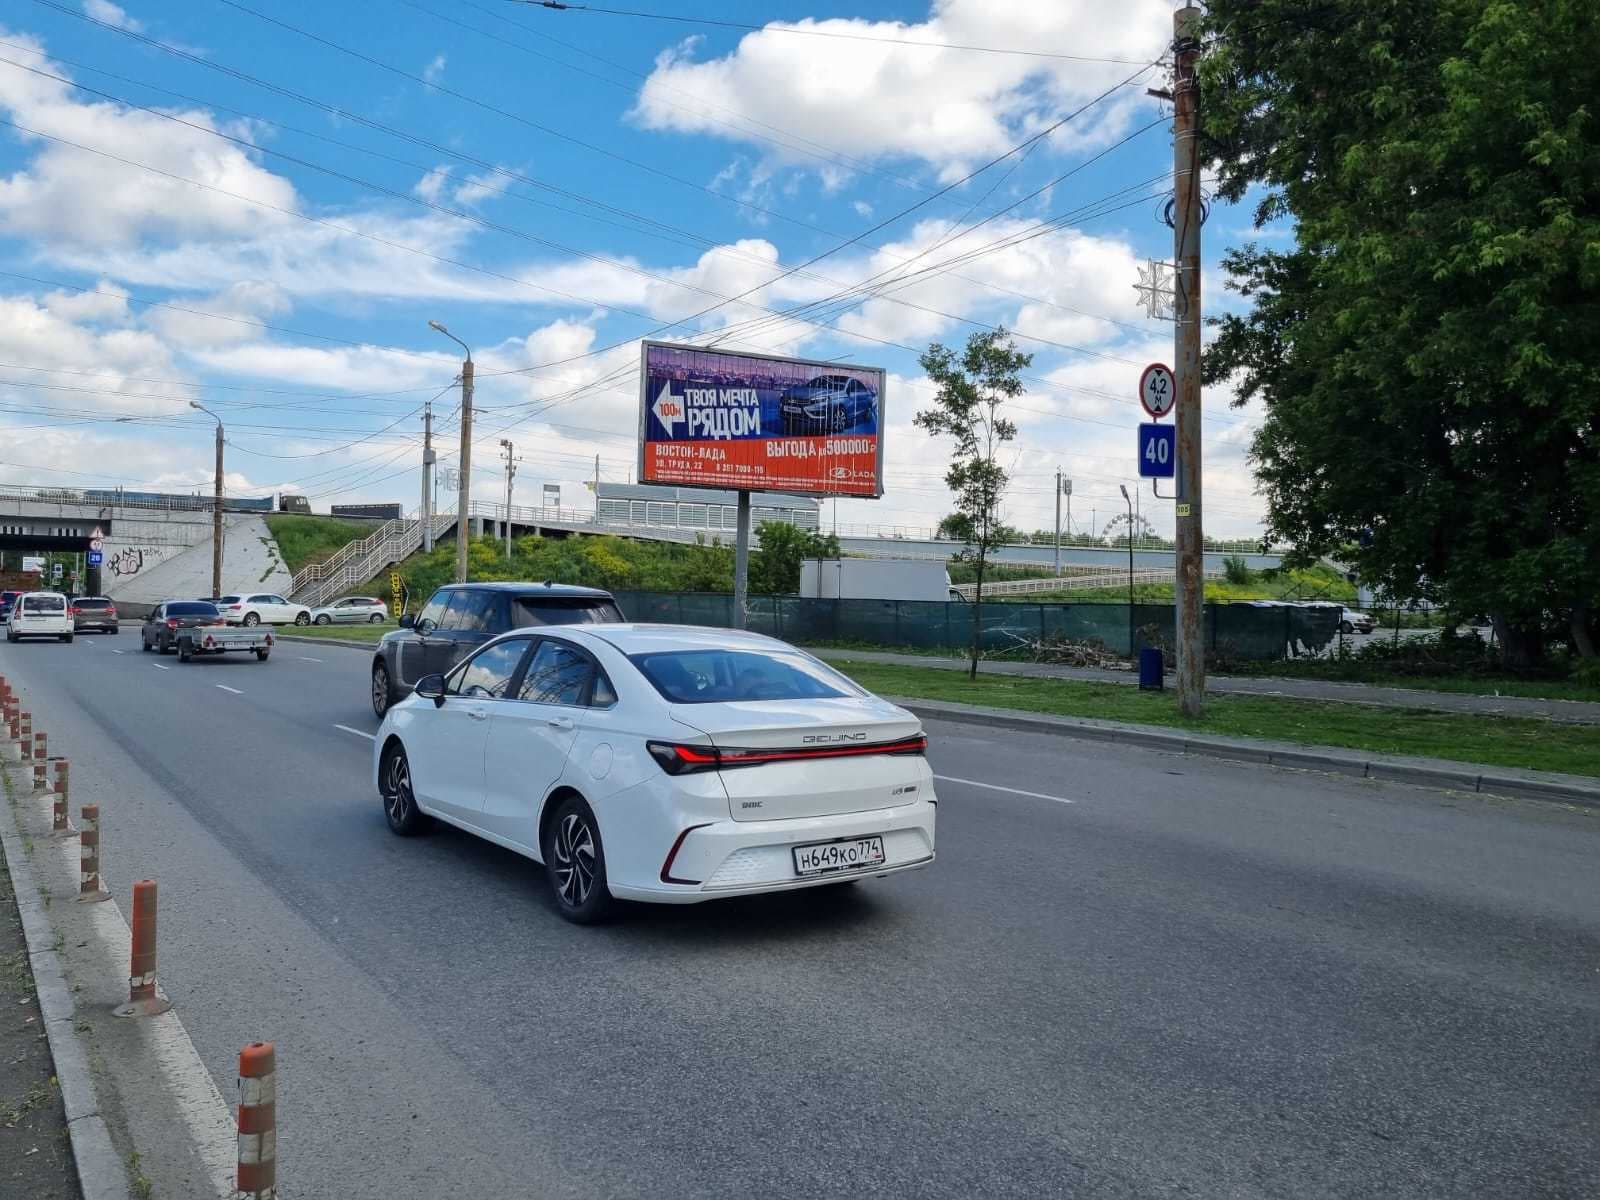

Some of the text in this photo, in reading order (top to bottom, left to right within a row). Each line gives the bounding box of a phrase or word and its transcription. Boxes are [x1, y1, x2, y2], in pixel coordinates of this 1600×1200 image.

[684, 388, 760, 407] ТВОЯ МЕЧТА
[687, 407, 761, 440] РЯДОМ
[766, 440, 817, 459] ВЫГОДА
[1145, 437, 1169, 464] 40
